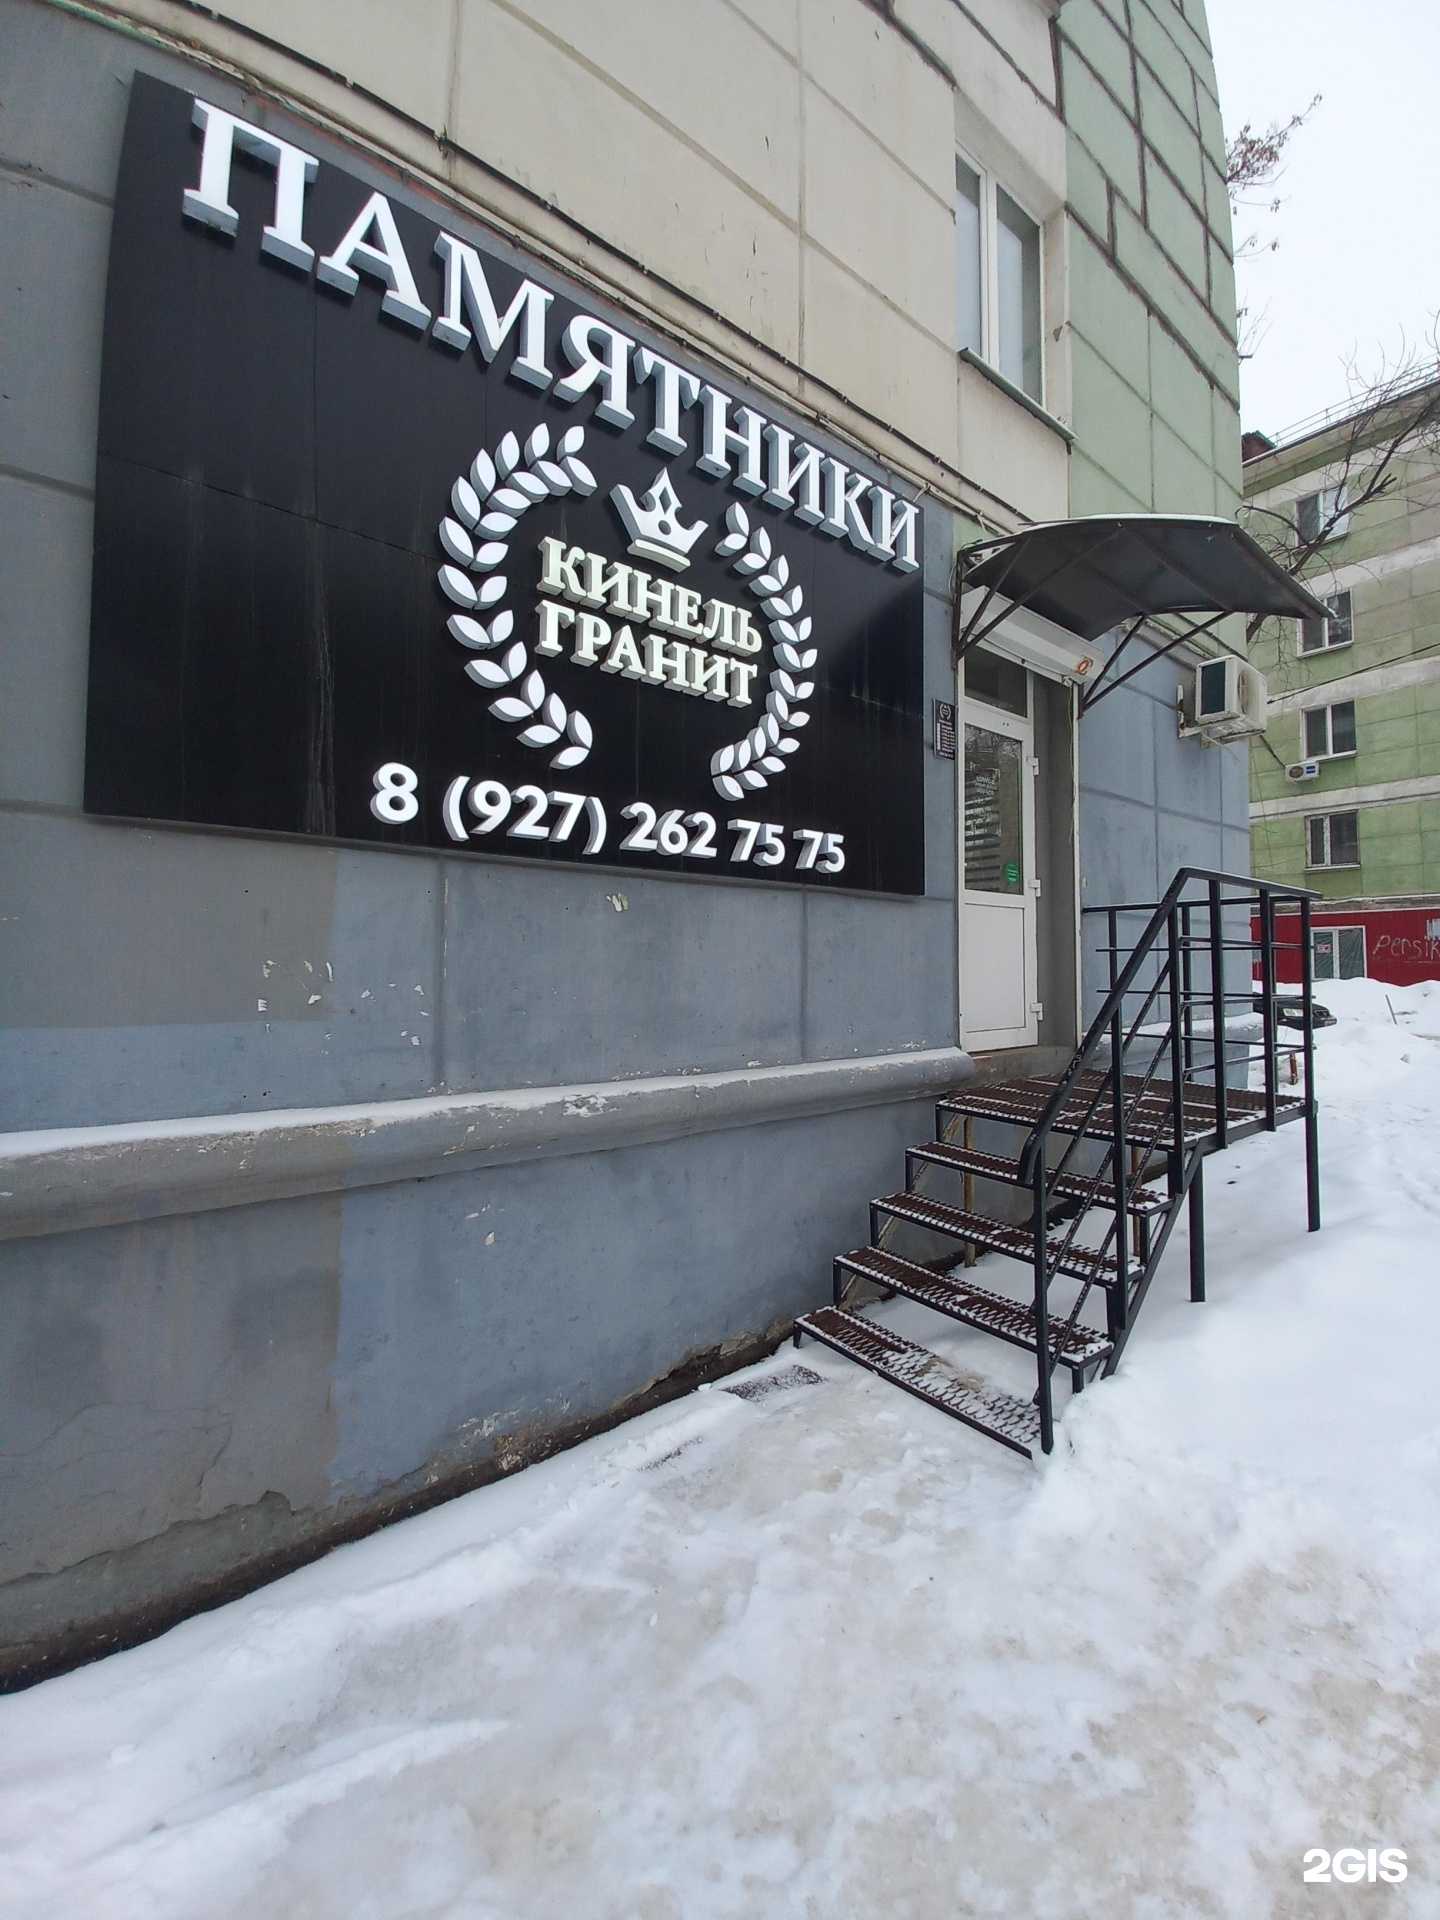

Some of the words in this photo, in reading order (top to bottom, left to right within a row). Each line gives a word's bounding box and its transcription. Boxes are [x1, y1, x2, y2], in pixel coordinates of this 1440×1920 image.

[182, 98, 920, 575] ПАМЯТНИКИ
[537, 536, 762, 655] КИНЕЛЬ
[534, 600, 757, 708] ГРАНИТ
[370, 762, 418, 824] 8
[442, 776, 607, 855] (927)
[620, 801, 717, 858] 262
[727, 819, 786, 867] 75
[793, 829, 846, 874] 75
